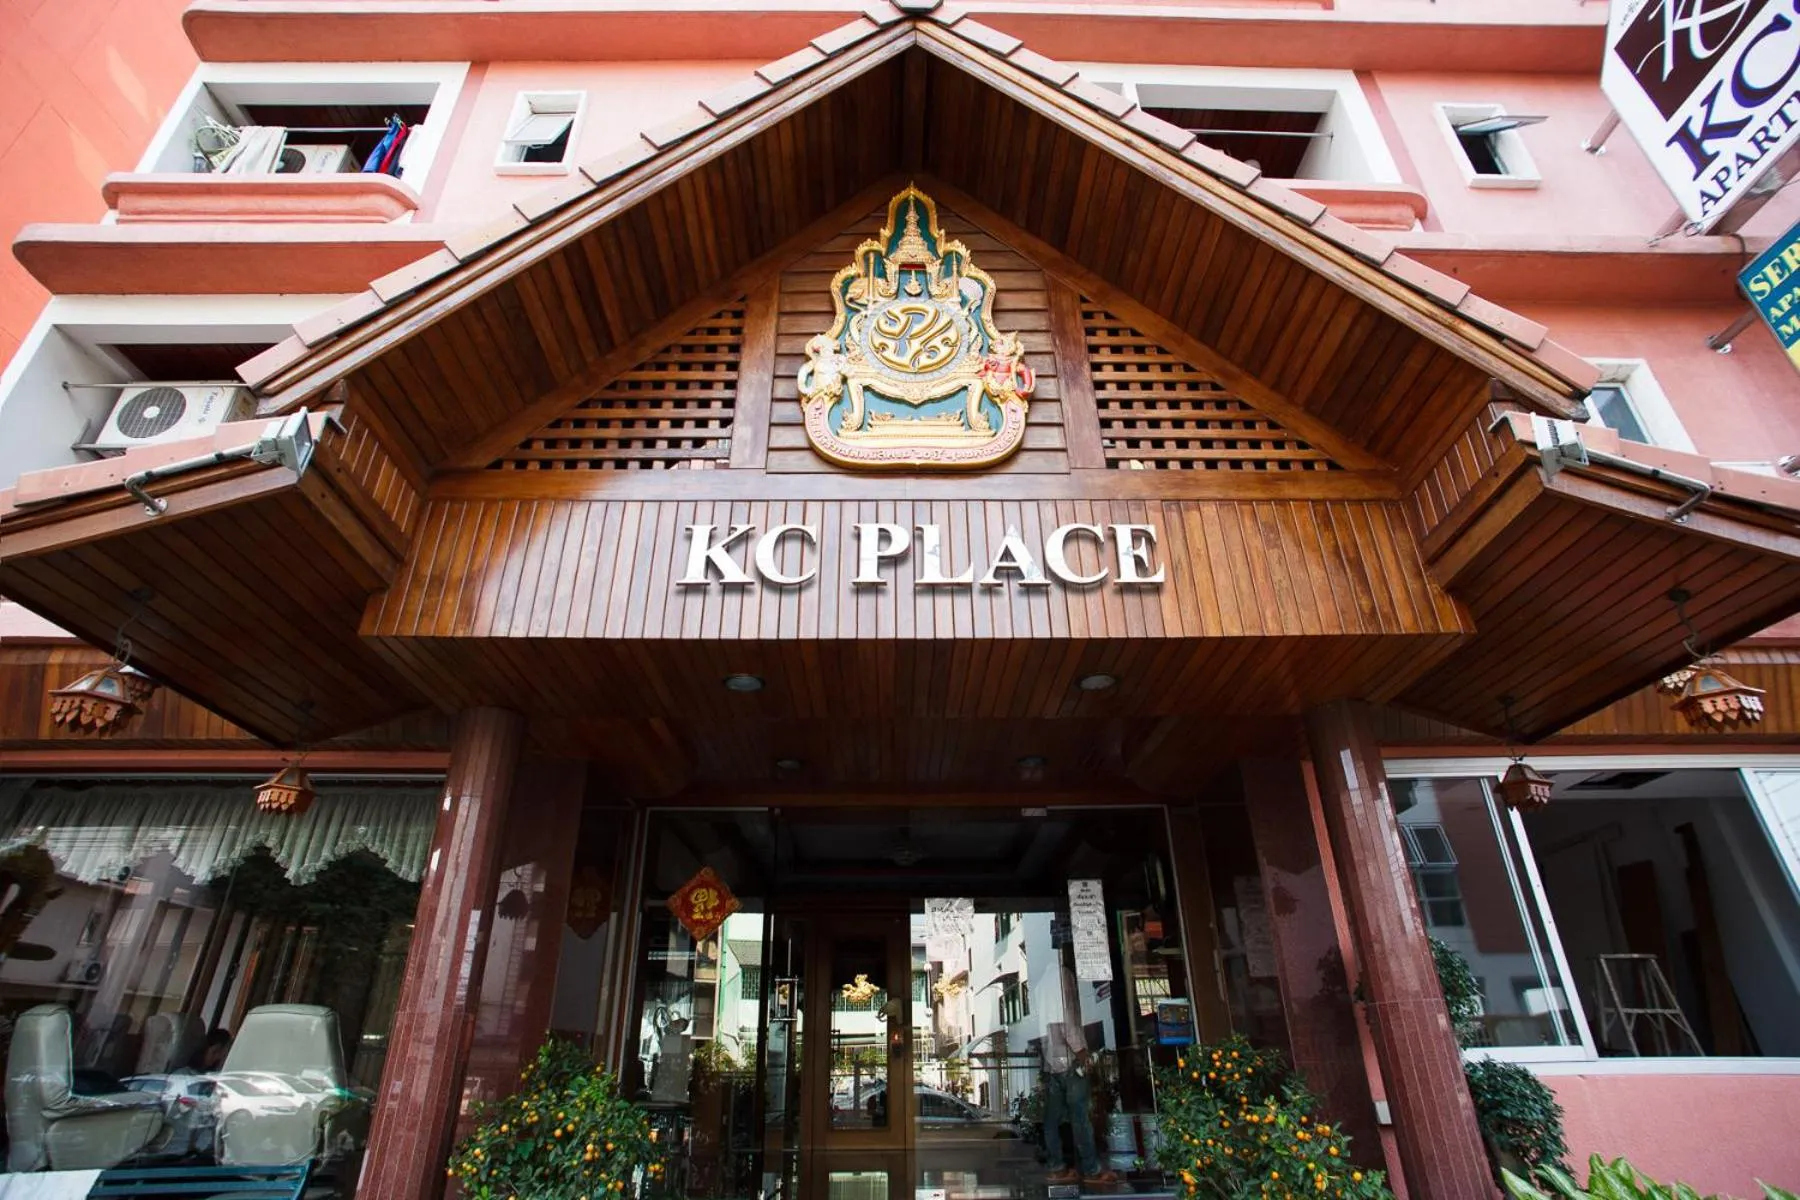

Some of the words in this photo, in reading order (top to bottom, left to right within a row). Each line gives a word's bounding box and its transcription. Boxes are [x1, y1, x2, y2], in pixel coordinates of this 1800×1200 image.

[1699, 90, 1800, 217] APART
[676, 523, 817, 588] KC
[851, 522, 1166, 588] PLACE
